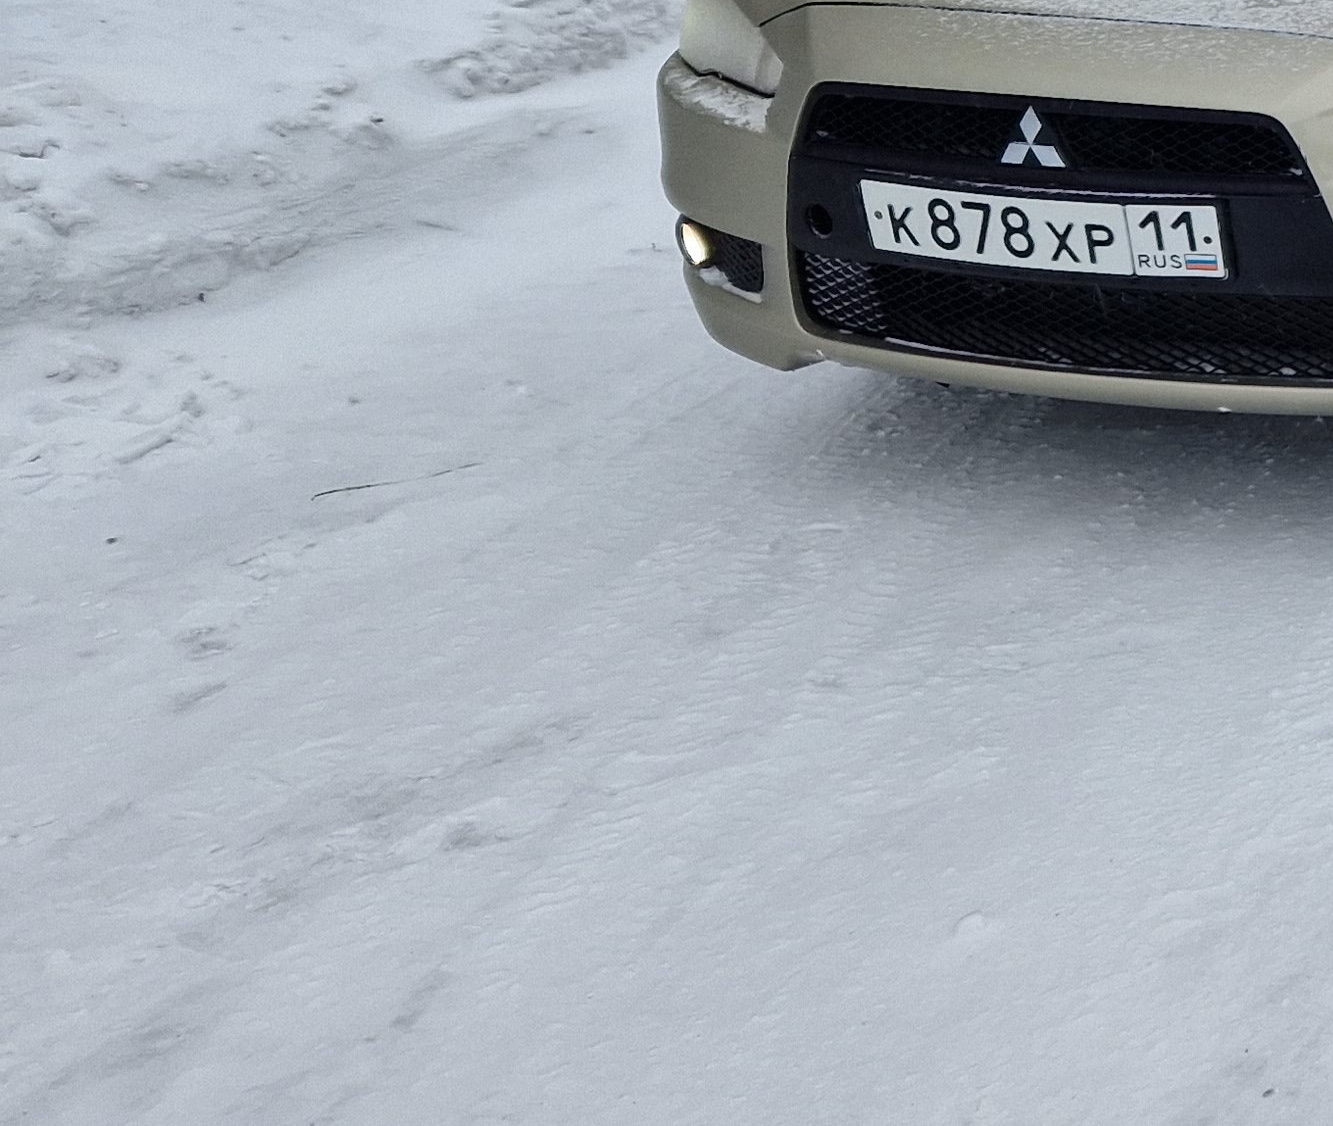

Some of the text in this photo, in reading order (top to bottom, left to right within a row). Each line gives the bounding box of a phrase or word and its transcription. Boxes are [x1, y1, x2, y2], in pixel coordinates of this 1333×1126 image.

[887, 198, 1198, 264] К878ХР 11
[1138, 253, 1183, 269] RUS
